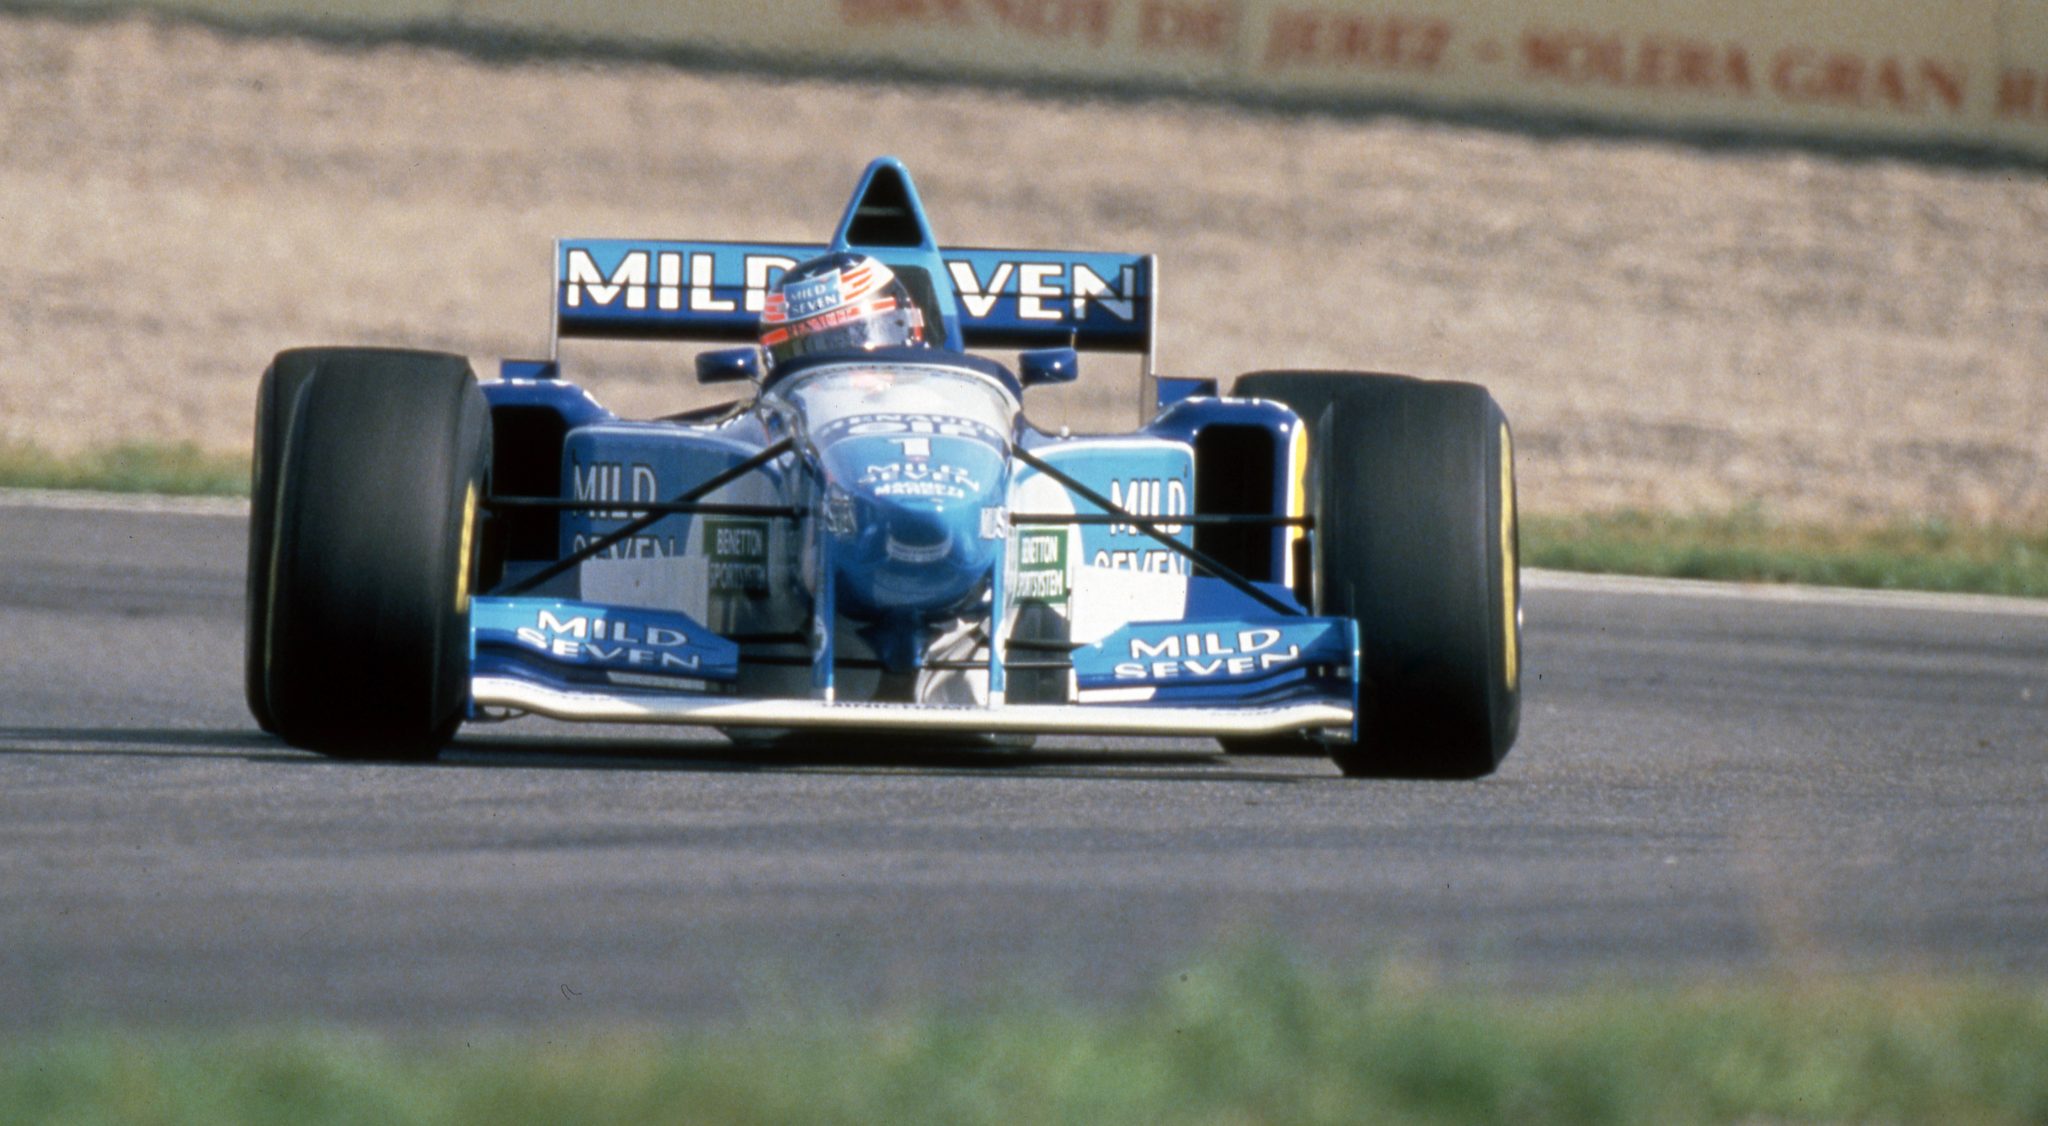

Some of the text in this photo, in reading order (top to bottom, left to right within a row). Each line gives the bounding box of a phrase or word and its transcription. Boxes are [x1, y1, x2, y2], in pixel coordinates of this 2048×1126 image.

[567, 250, 1134, 320] MILD VEN
[573, 464, 657, 518] MILD
[1109, 480, 1187, 536] MILD
[517, 627, 699, 670] SEVEN
[538, 610, 688, 647] MILD
[1131, 628, 1282, 660] MILD
[1113, 645, 1299, 678] SEVEN
